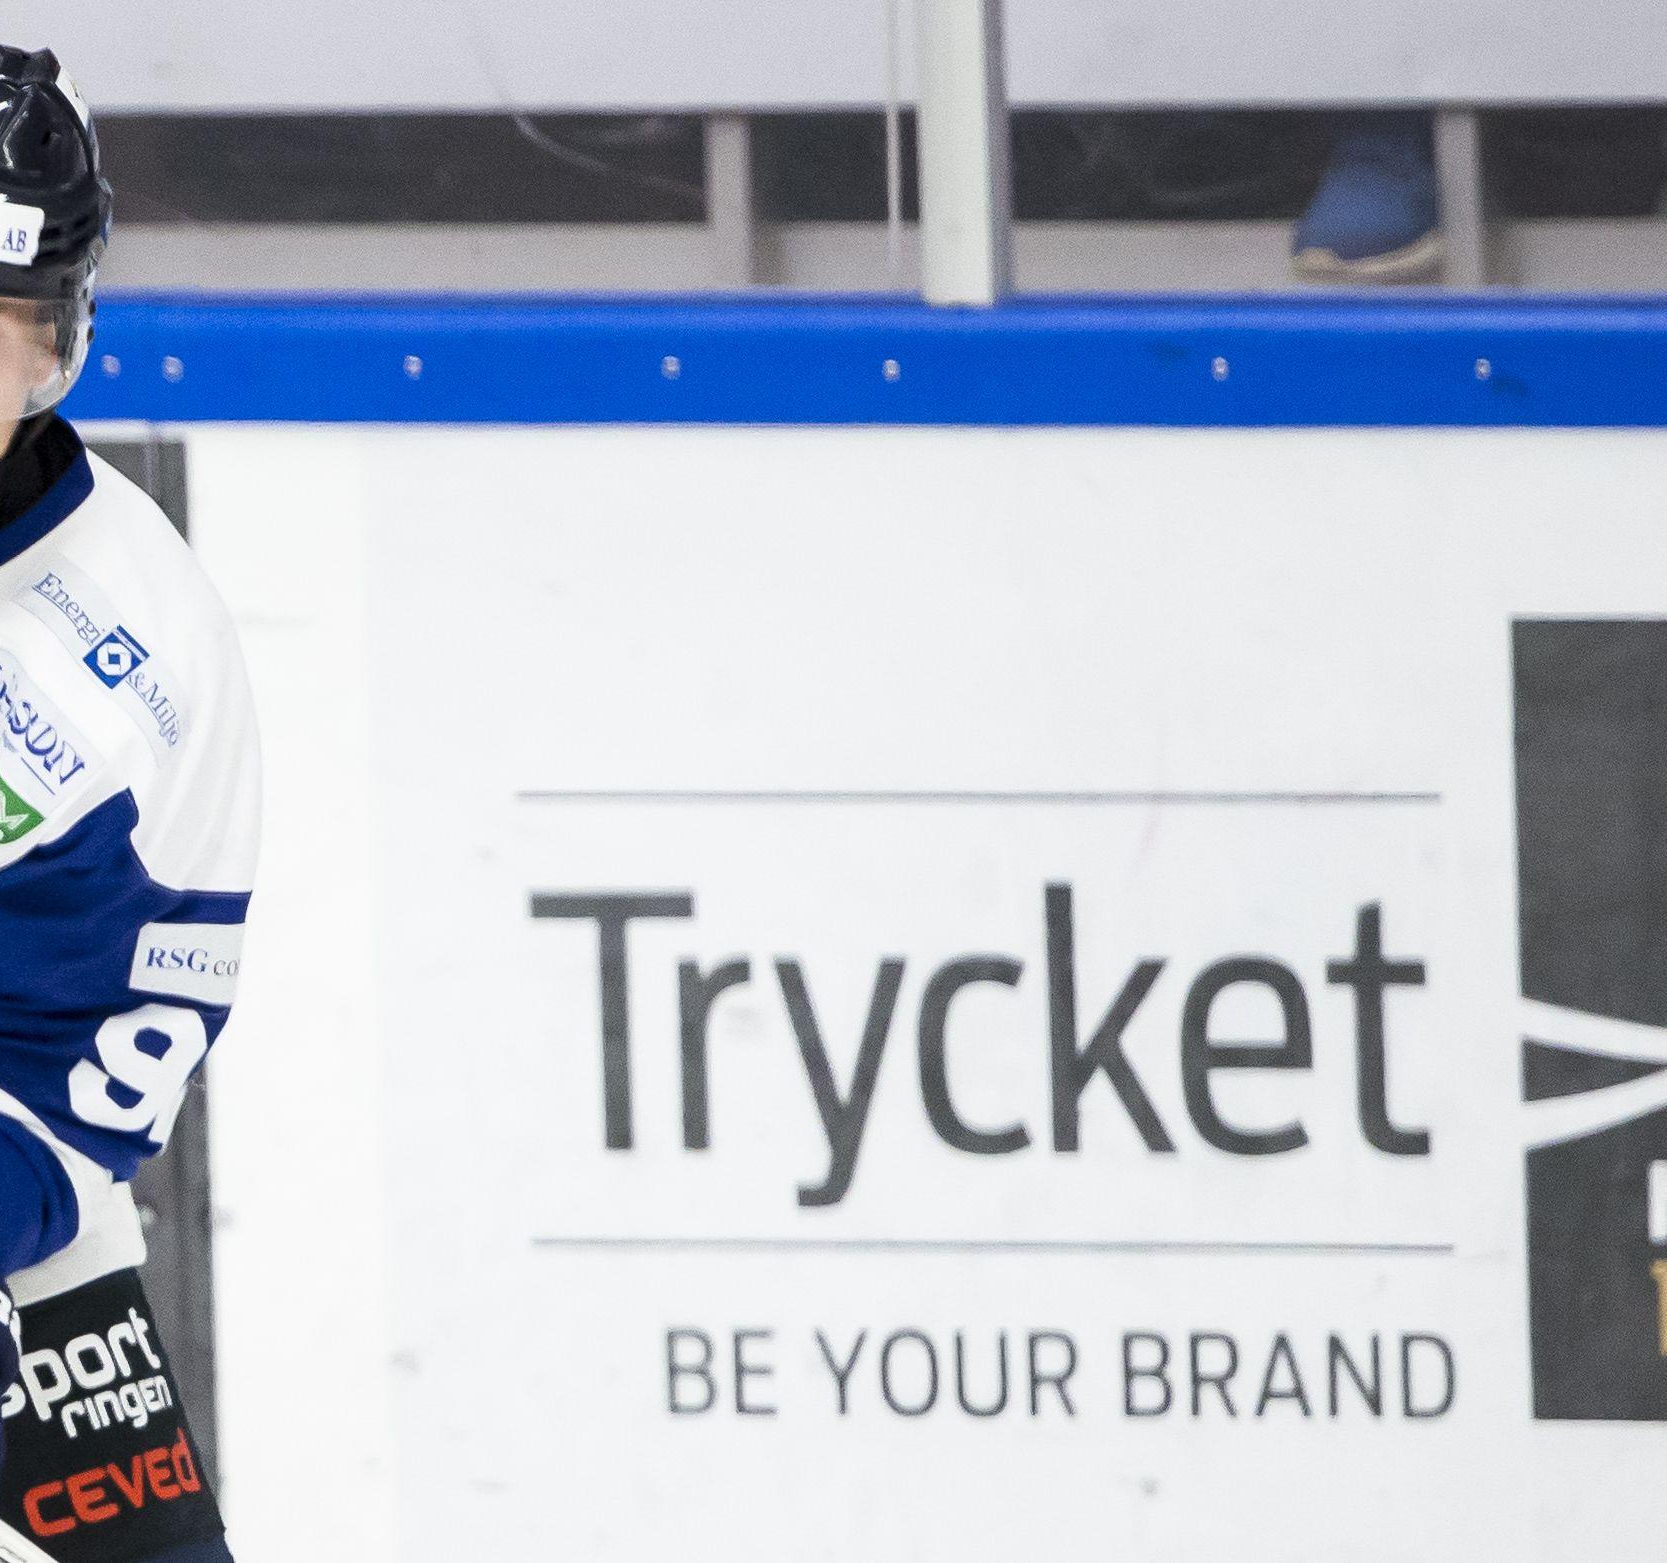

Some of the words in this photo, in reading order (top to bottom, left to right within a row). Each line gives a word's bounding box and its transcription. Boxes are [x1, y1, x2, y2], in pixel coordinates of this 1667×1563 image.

[2, 227, 27, 252] AB
[33, 572, 105, 647] Energi
[146, 946, 210, 974] RSG
[526, 882, 1433, 1208] Trycket
[663, 1326, 778, 1418] BE
[813, 1327, 1079, 1418] YOUR
[1121, 1329, 1457, 1419] BRAND
